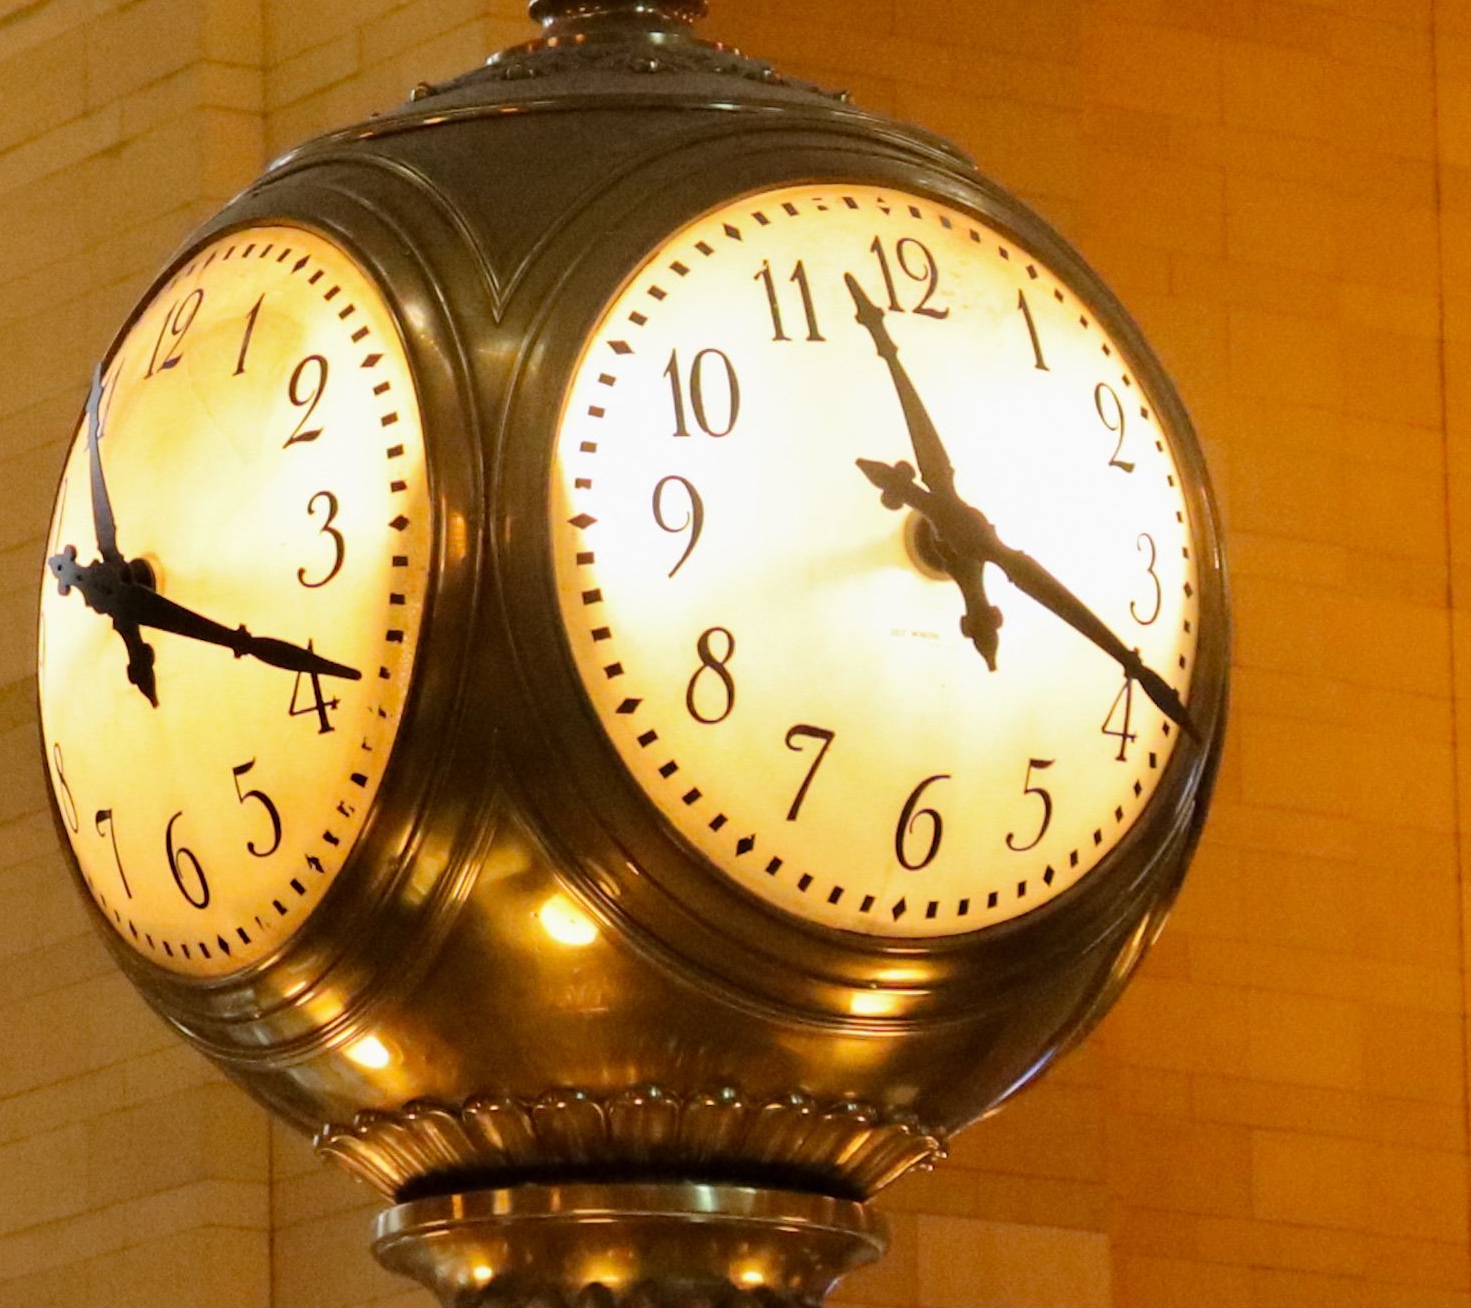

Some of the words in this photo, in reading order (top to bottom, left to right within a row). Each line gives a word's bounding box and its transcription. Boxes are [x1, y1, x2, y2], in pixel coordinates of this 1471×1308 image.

[754, 259, 826, 342] 11
[870, 235, 950, 320] 12
[144, 288, 204, 379] 12
[232, 292, 265, 376] 1
[1017, 288, 1050, 372] 1
[284, 354, 328, 449] 2
[663, 348, 740, 438] 10
[1093, 382, 1136, 474] 2
[297, 490, 346, 588] 3
[652, 475, 705, 579] 9
[1130, 533, 1162, 626] 3
[288, 638, 341, 734] 4
[686, 626, 736, 724] 8
[1101, 666, 1138, 762] 4
[52, 742, 79, 835] 8
[232, 756, 283, 859] 5
[784, 724, 836, 821] 7
[1005, 758, 1056, 852] 5
[94, 808, 133, 900] 7
[164, 810, 210, 910] 6
[894, 774, 952, 871] 6
